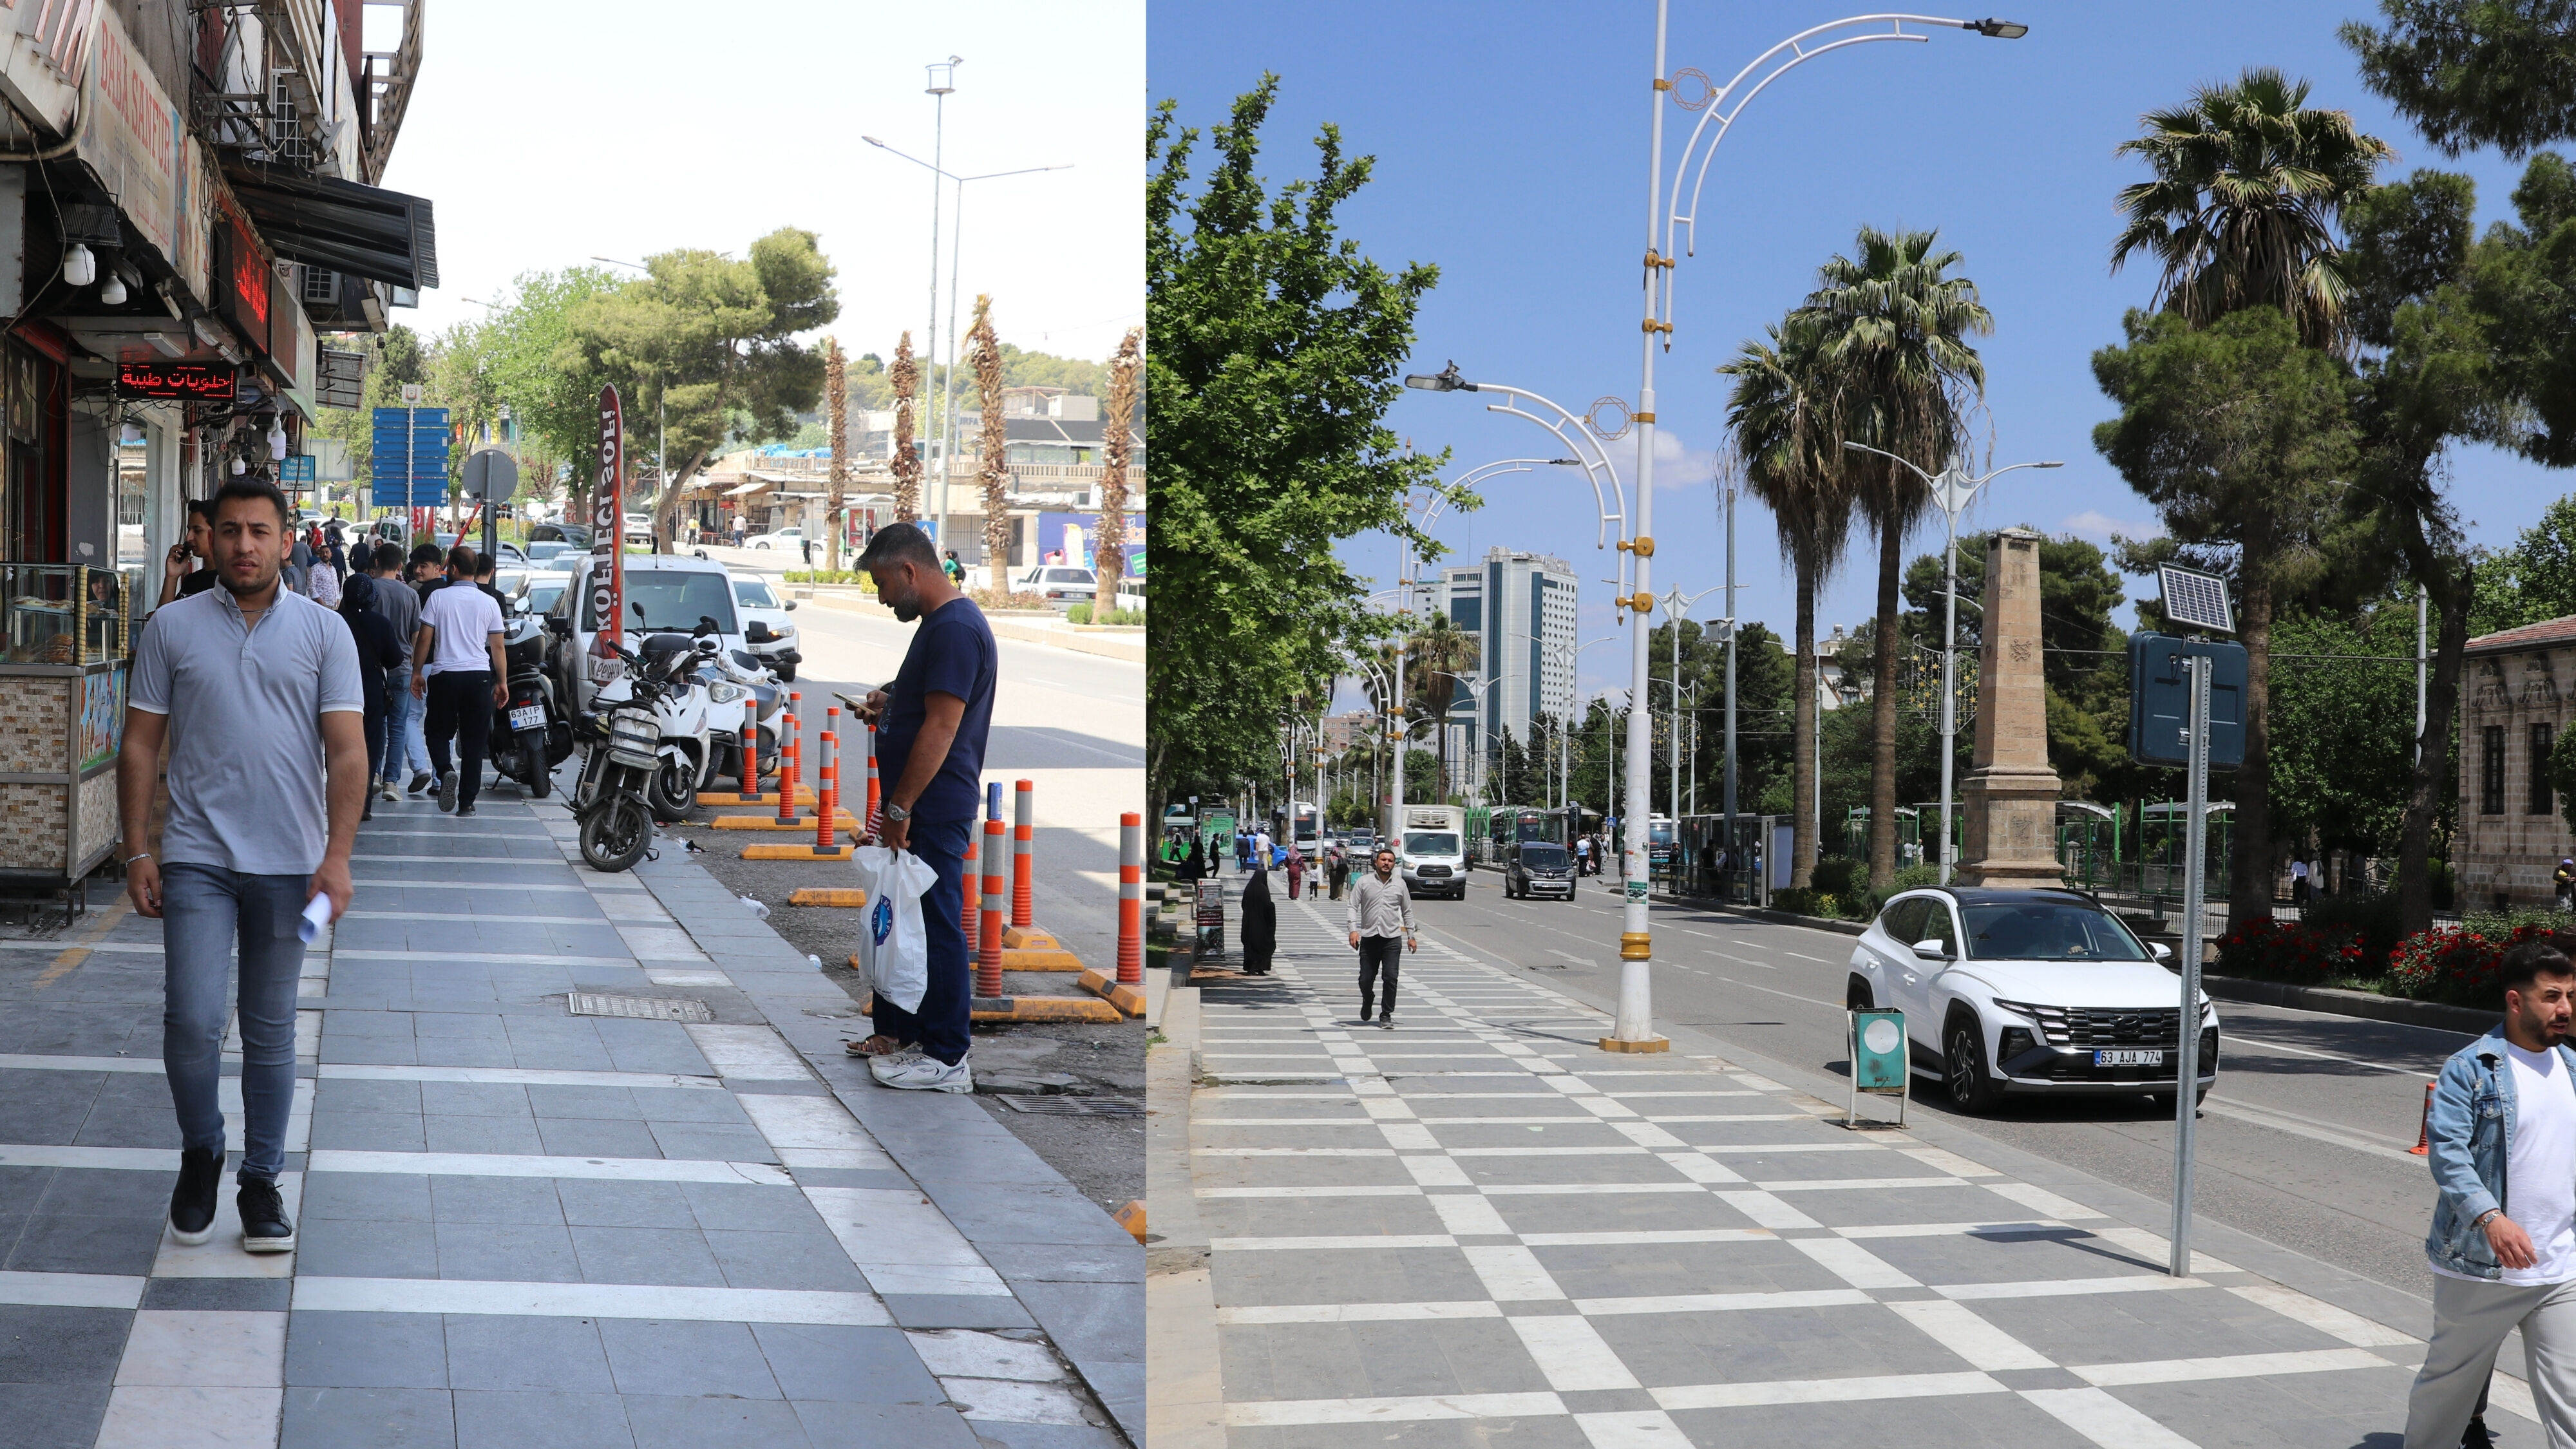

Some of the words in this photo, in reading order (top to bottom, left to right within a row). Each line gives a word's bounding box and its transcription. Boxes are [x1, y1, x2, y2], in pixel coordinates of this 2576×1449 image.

[101, 19, 129, 125] BABA
[132, 69, 170, 180] SANFUR
[122, 368, 162, 389] طيبة
[167, 373, 230, 392] حلويات
[524, 716, 538, 725] 177
[2101, 1052, 2113, 1063] 63
[2119, 1051, 2137, 1063] AJA
[2143, 1051, 2161, 1063] 774
